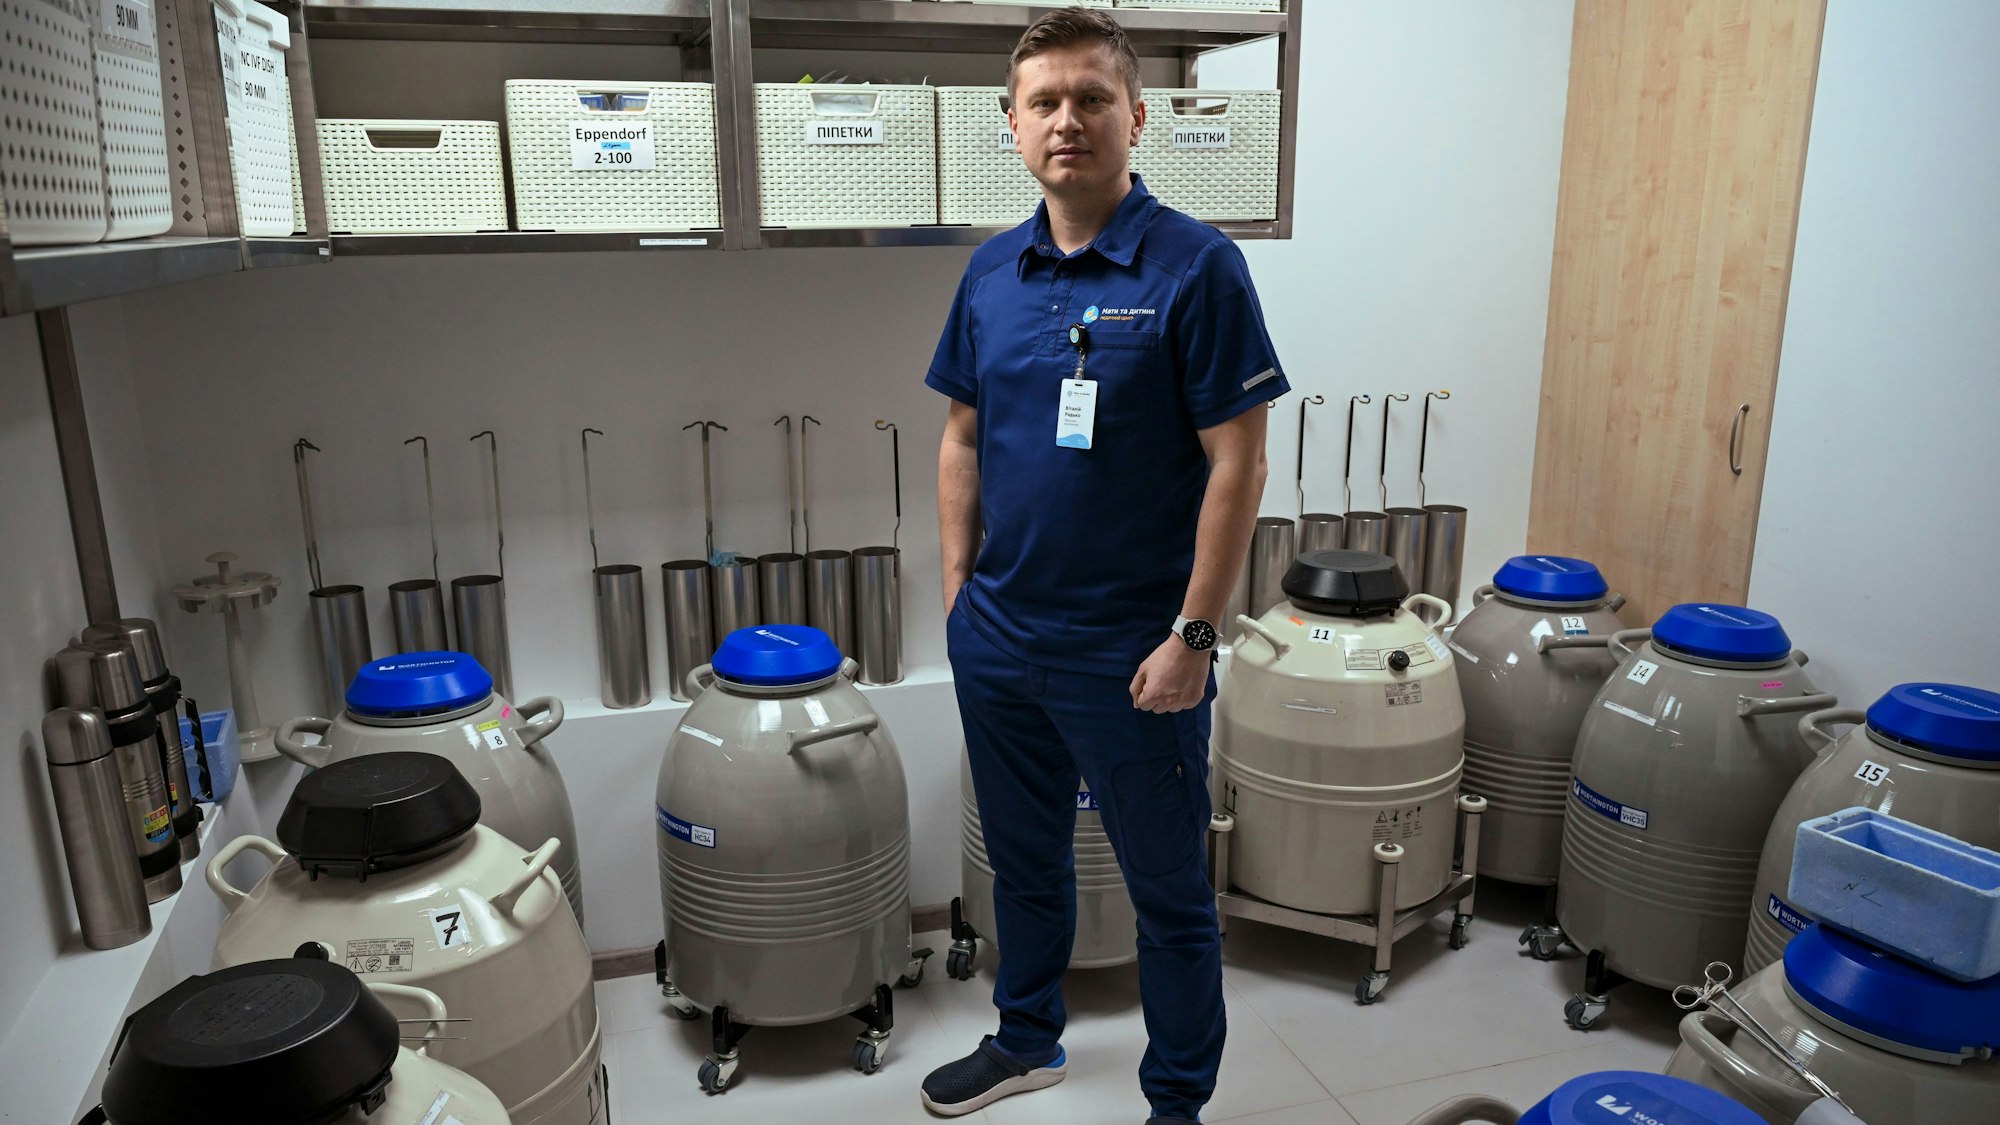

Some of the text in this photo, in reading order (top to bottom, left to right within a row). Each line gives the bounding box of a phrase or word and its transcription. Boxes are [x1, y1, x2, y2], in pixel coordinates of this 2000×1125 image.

[116, 4, 139, 31] 90 MM
[251, 53, 261, 72] IVF
[261, 58, 275, 75] DISH
[244, 81, 267, 100] 90 MM
[575, 127, 647, 143] Eppendorf
[817, 126, 873, 138] ПІПЕТКИ
[1175, 132, 1225, 143] ПІПЕТКИ
[594, 152, 633, 164] 2-100
[1563, 617, 1581, 629] 12
[1312, 628, 1331, 641] 11
[1632, 664, 1650, 679] 14
[494, 735, 503, 746] 8
[1858, 763, 1884, 782] 15
[1580, 788, 1619, 815] WORTHINGTON
[1622, 813, 1645, 826] VHC35
[694, 833, 711, 844] HC34
[435, 911, 461, 946] 7
[1634, 1111, 1665, 1125] WO
